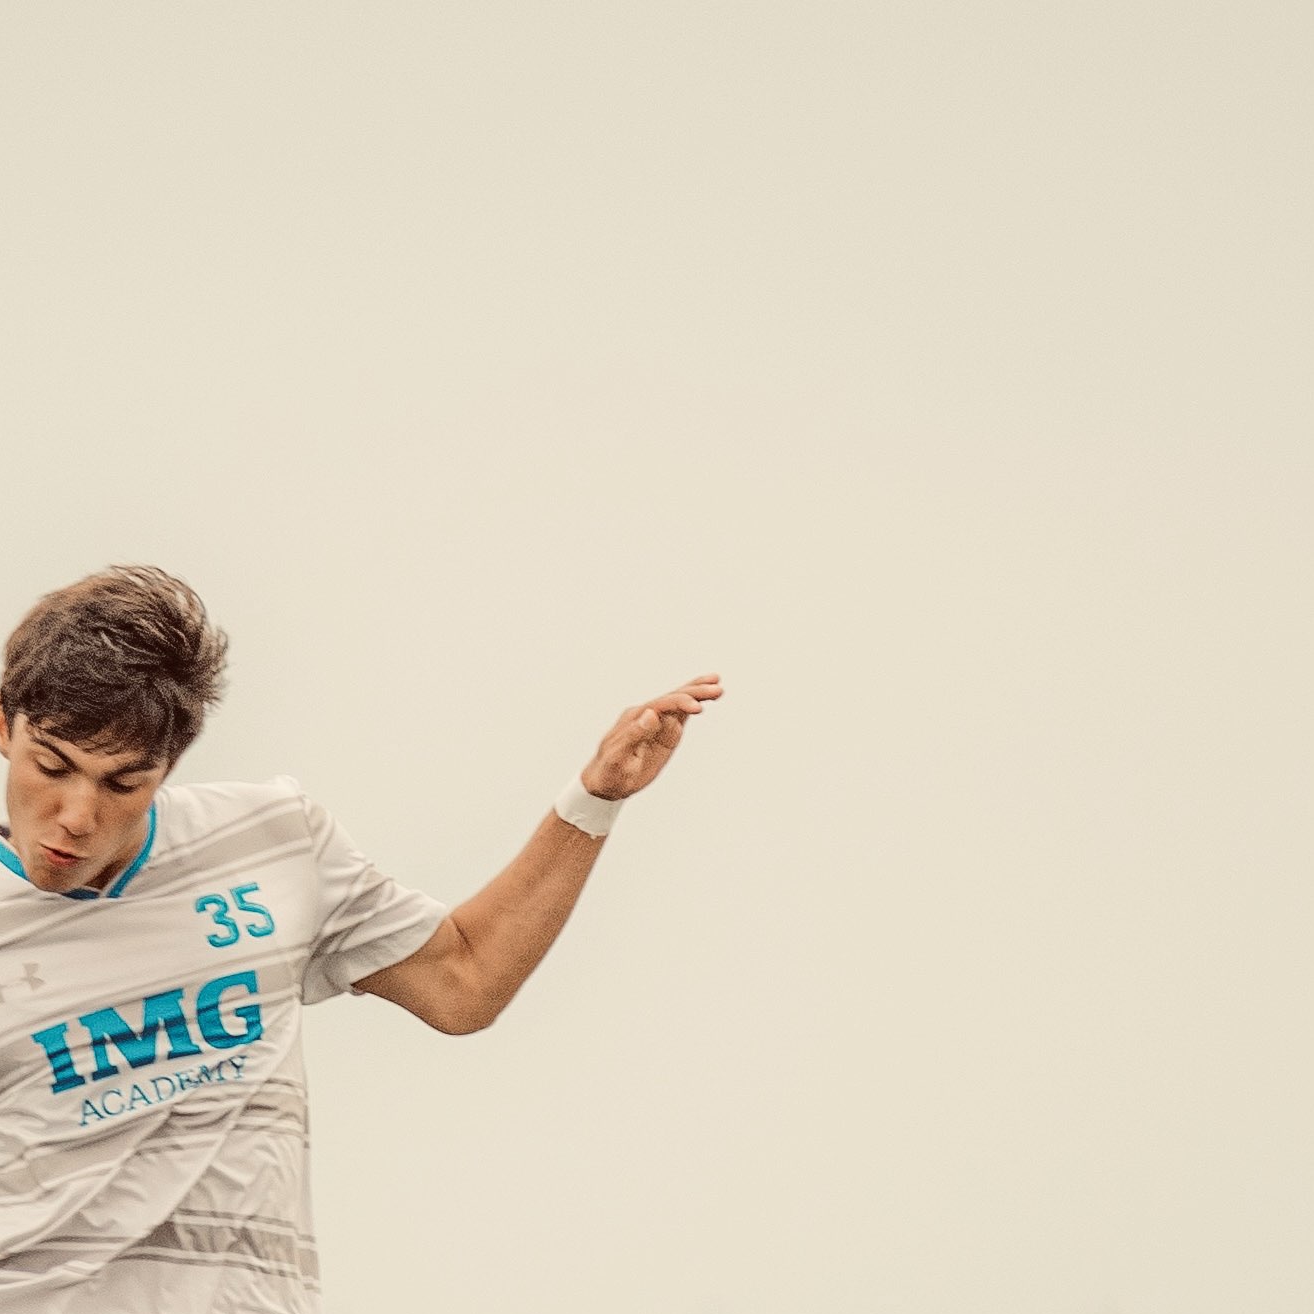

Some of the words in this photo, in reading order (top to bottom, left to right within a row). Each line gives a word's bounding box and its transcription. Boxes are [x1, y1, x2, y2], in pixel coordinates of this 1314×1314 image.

[194, 882, 275, 949] 35
[31, 969, 264, 1096] IMG
[78, 1055, 249, 1127] ACADEMY
